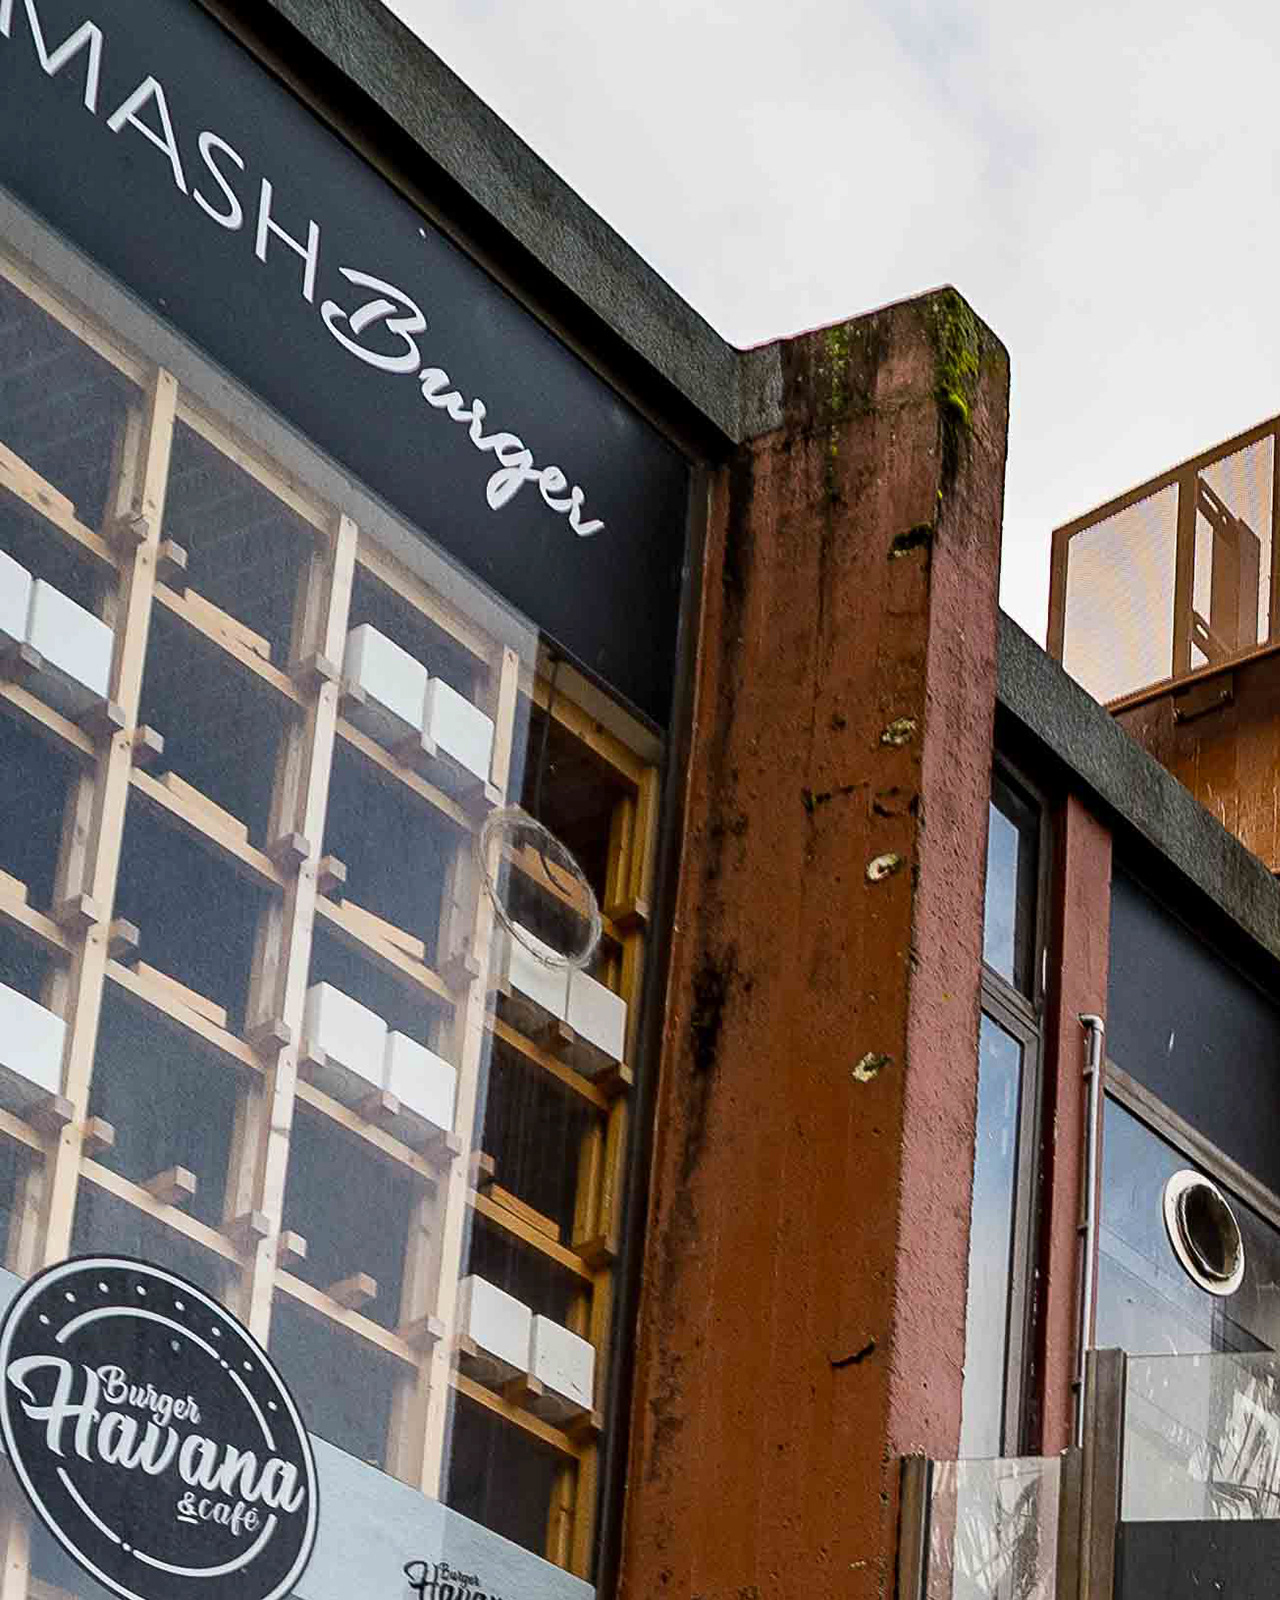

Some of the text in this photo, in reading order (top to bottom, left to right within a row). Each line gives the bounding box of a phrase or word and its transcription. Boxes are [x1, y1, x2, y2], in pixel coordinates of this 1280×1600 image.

[320, 266, 605, 538] Burger
[6, 1354, 306, 1514] Havana
[96, 1364, 202, 1426] Burger
[438, 1561, 481, 1589] Burger
